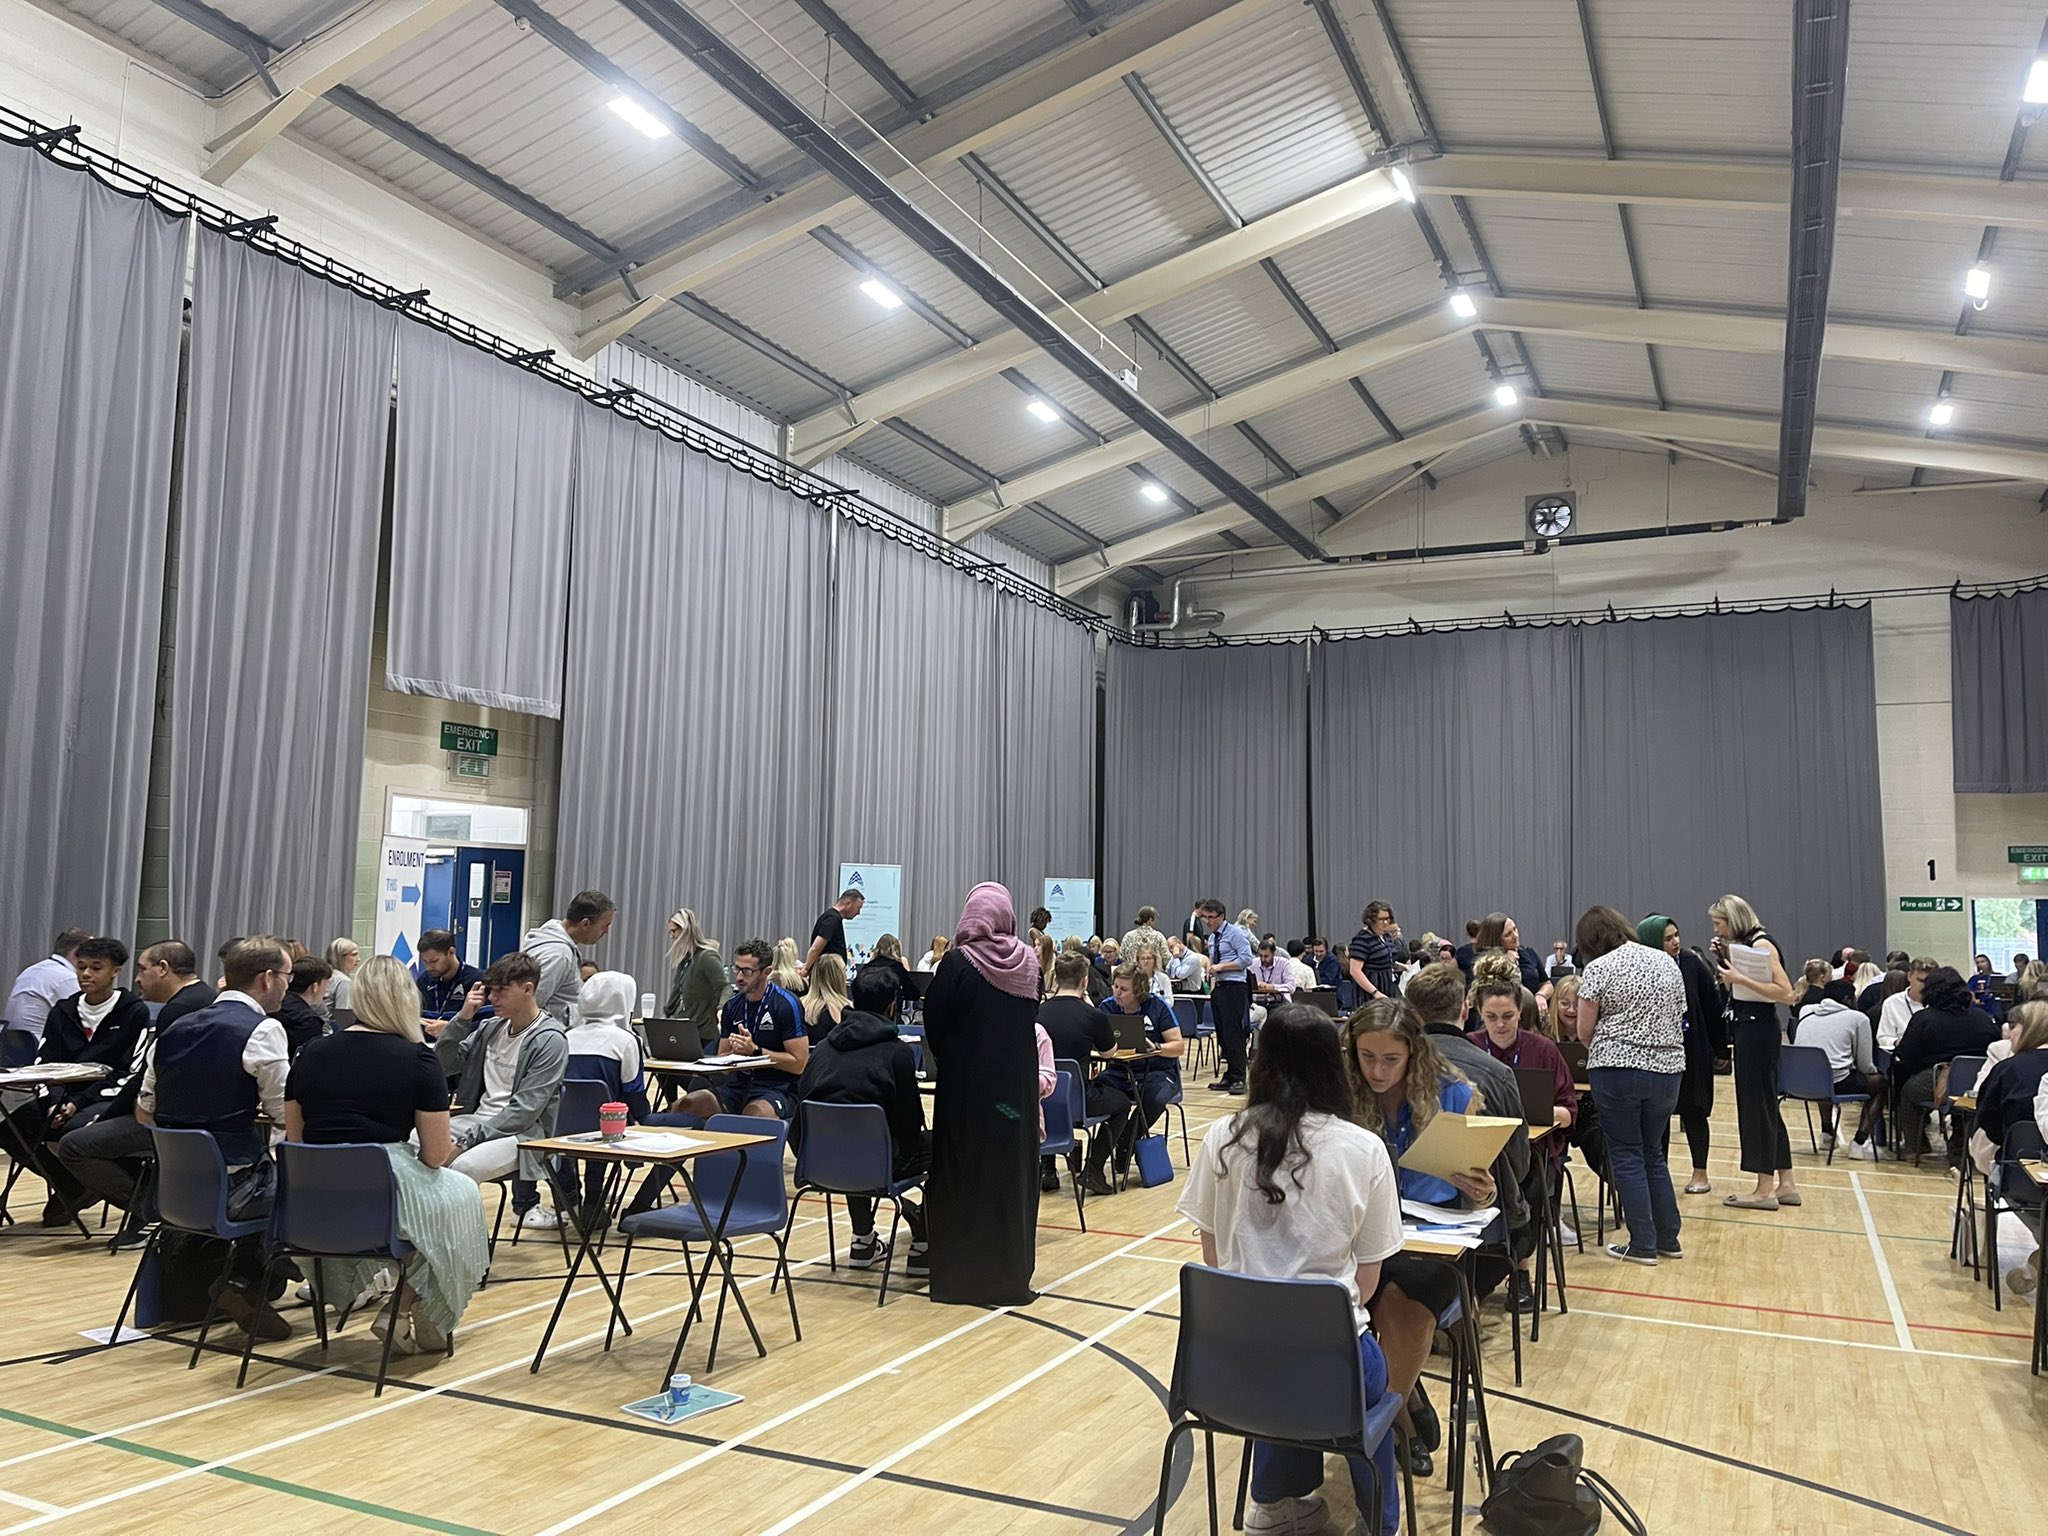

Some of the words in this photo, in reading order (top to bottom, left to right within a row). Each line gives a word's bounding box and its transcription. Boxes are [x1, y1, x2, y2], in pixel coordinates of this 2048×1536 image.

[444, 725, 495, 739] EMERGENCY
[457, 737, 482, 752] EXIT
[388, 850, 424, 867] ENROLMENT
[2023, 854, 2047, 862] EXIT
[1927, 860, 1936, 880] 1
[386, 878, 397, 891] THIS
[384, 899, 396, 912] WAY
[1901, 900, 1917, 908] Fire
